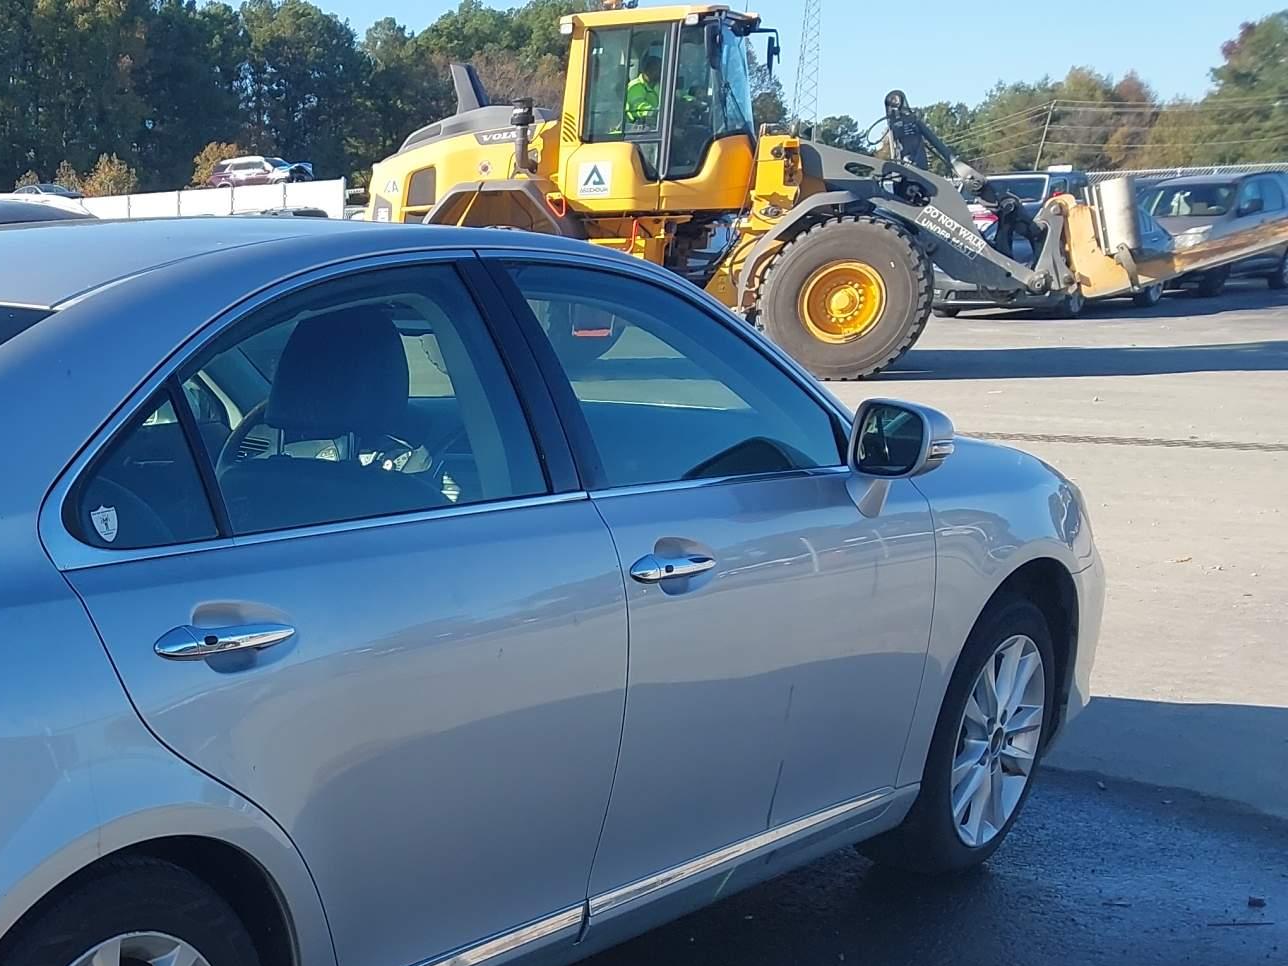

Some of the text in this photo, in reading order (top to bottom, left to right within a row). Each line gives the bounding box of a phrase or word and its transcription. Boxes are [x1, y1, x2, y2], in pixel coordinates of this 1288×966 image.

[481, 130, 531, 143] VOL
[921, 218, 951, 239] UNDER
[923, 206, 984, 250] DO NOT WALK
